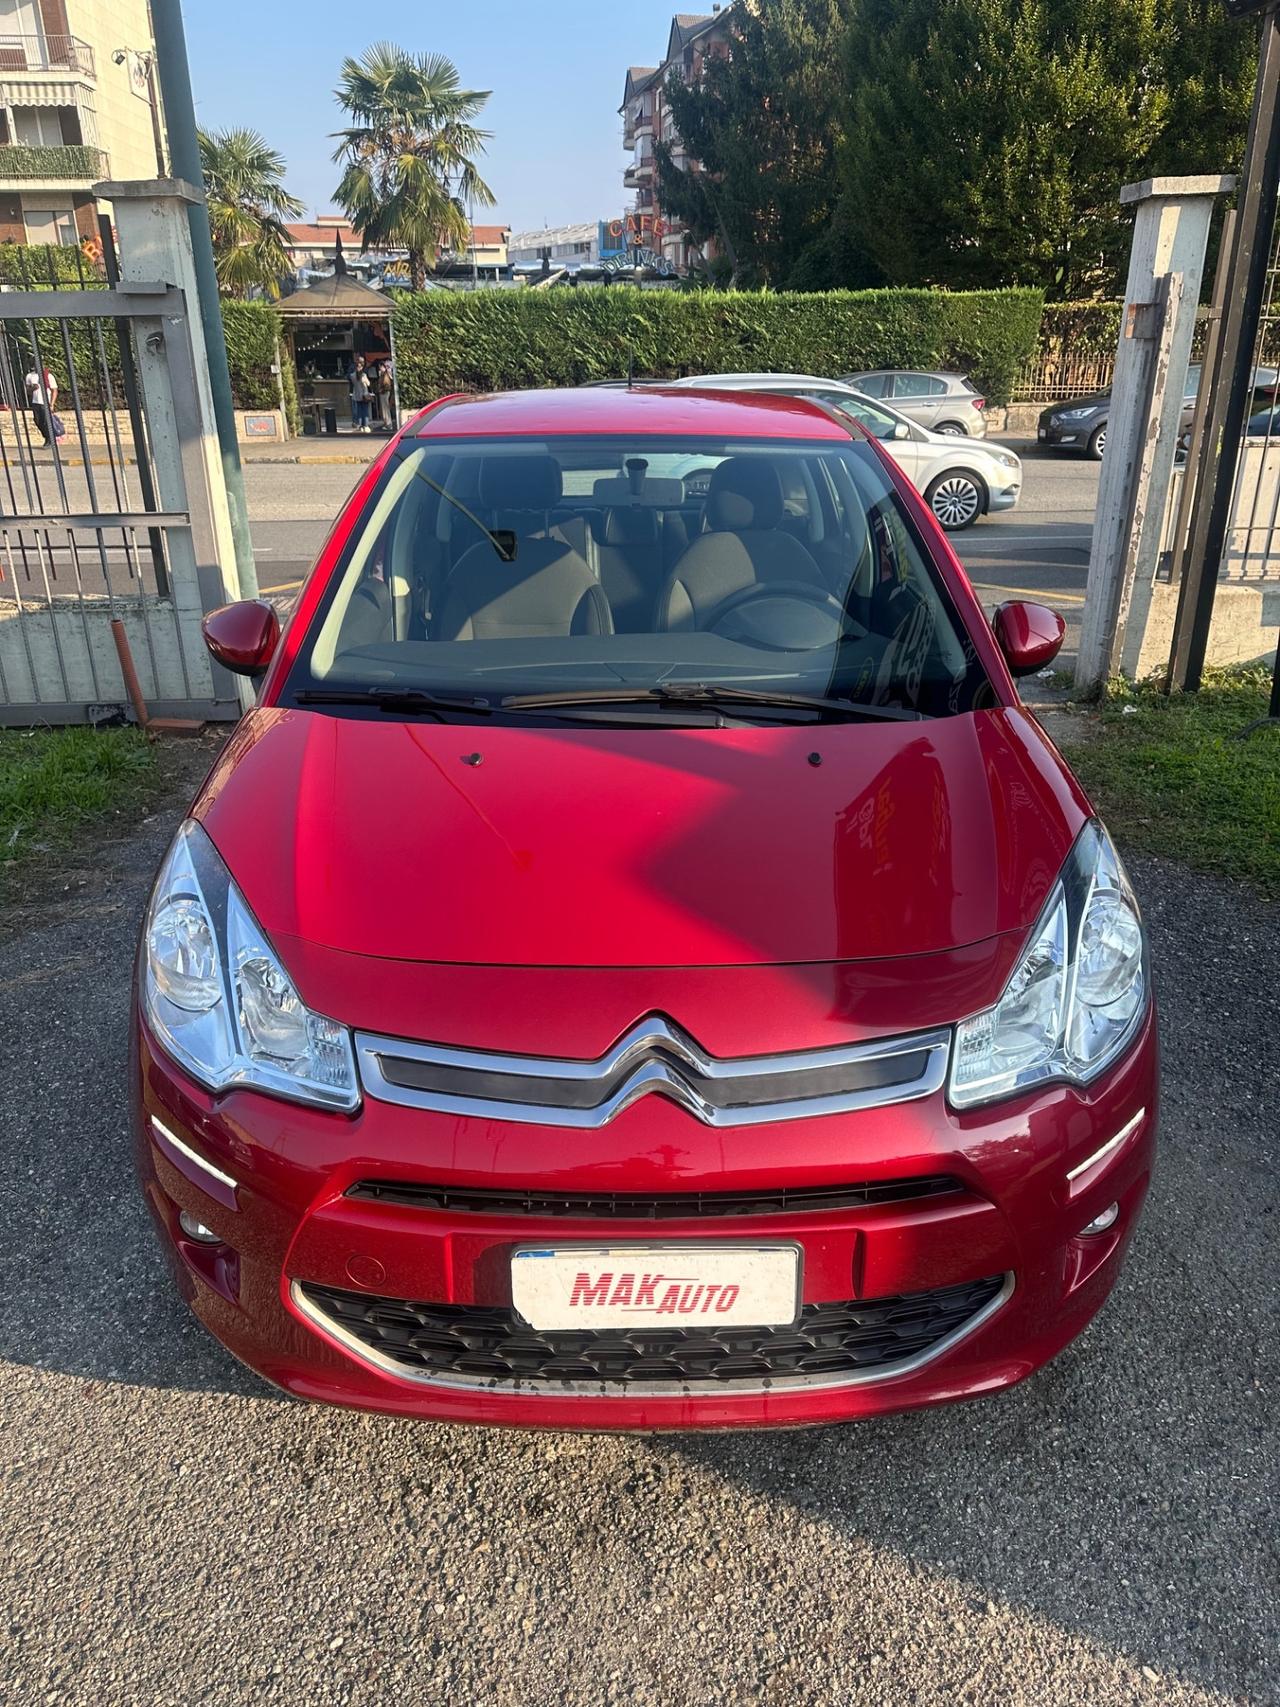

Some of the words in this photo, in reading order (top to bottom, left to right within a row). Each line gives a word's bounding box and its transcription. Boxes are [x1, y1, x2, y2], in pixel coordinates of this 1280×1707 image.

[633, 233, 643, 245] &
[604, 249, 673, 276] DRINKS
[569, 1272, 664, 1306] MAK
[656, 1285, 740, 1313] AUTO
